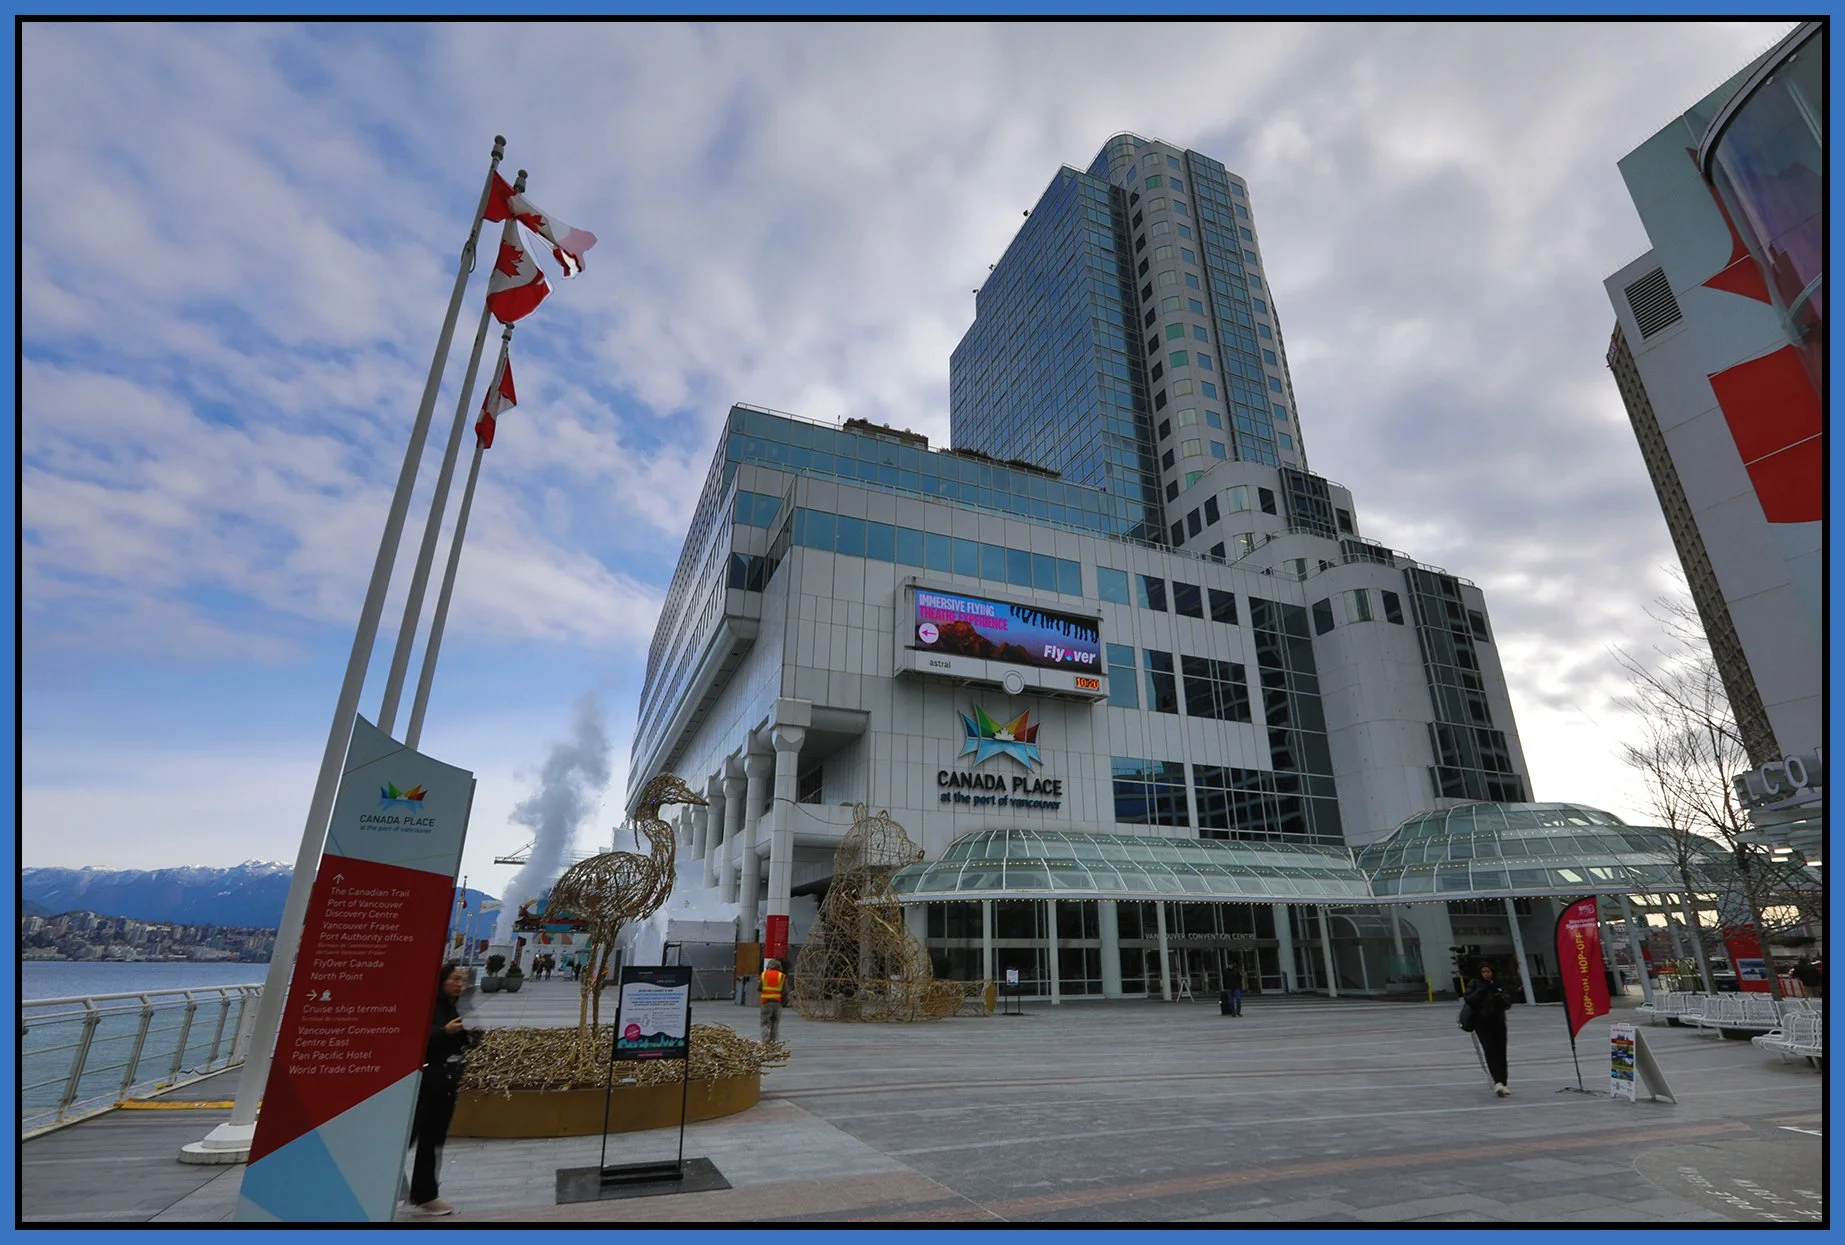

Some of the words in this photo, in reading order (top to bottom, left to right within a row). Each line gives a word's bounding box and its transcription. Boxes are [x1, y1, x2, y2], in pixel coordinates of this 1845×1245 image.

[919, 594, 966, 613] IMMERSIVE
[967, 602, 995, 617] FLYING
[919, 604, 957, 622] THEATRE
[958, 612, 1009, 632] EXPERIENCE
[929, 660, 952, 669] astral
[1075, 676, 1100, 689] 10:20
[938, 770, 1007, 792] CANADA
[1012, 776, 1063, 795] PLACE
[940, 792, 951, 803] at
[953, 791, 971, 804] the
[973, 795, 996, 807] port
[998, 794, 1009, 806] of
[1010, 797, 1062, 810] vancouver
[360, 814, 400, 825] CANADA
[403, 816, 435, 827] PLACE
[331, 887, 346, 896] The
[348, 887, 389, 897] Canadian
[391, 889, 410, 897] Trail
[327, 899, 346, 908] Port
[347, 899, 357, 908] of
[359, 900, 404, 909] Vancouver
[325, 909, 367, 920] Discovery
[368, 910, 399, 919] Centre
[322, 921, 367, 930] Vancouver
[370, 922, 400, 931] Fraser
[320, 932, 339, 941] Port
[340, 932, 383, 943] Authority
[384, 933, 414, 942] offices
[1187, 932, 1231, 941] CONVENTION
[1232, 932, 1257, 941] CENTRE
[1576, 932, 1588, 973] HOP-OFF
[313, 959, 347, 969] FlyOver
[349, 959, 384, 968] Canada
[310, 972, 337, 981] North
[339, 972, 364, 981] Point
[303, 1004, 333, 1014] Cruise
[335, 1004, 355, 1014] ship
[357, 1004, 397, 1013] terminal
[298, 1026, 347, 1035] Vancouver
[347, 1025, 400, 1034] Convention
[295, 1037, 326, 1047] Centre
[328, 1037, 350, 1047] East
[291, 1051, 310, 1060] Pan
[312, 1050, 343, 1060] Pacific
[346, 1050, 373, 1060] Hotel
[288, 1065, 317, 1074] World
[319, 1064, 346, 1074] Trade
[348, 1064, 381, 1073] Centre
